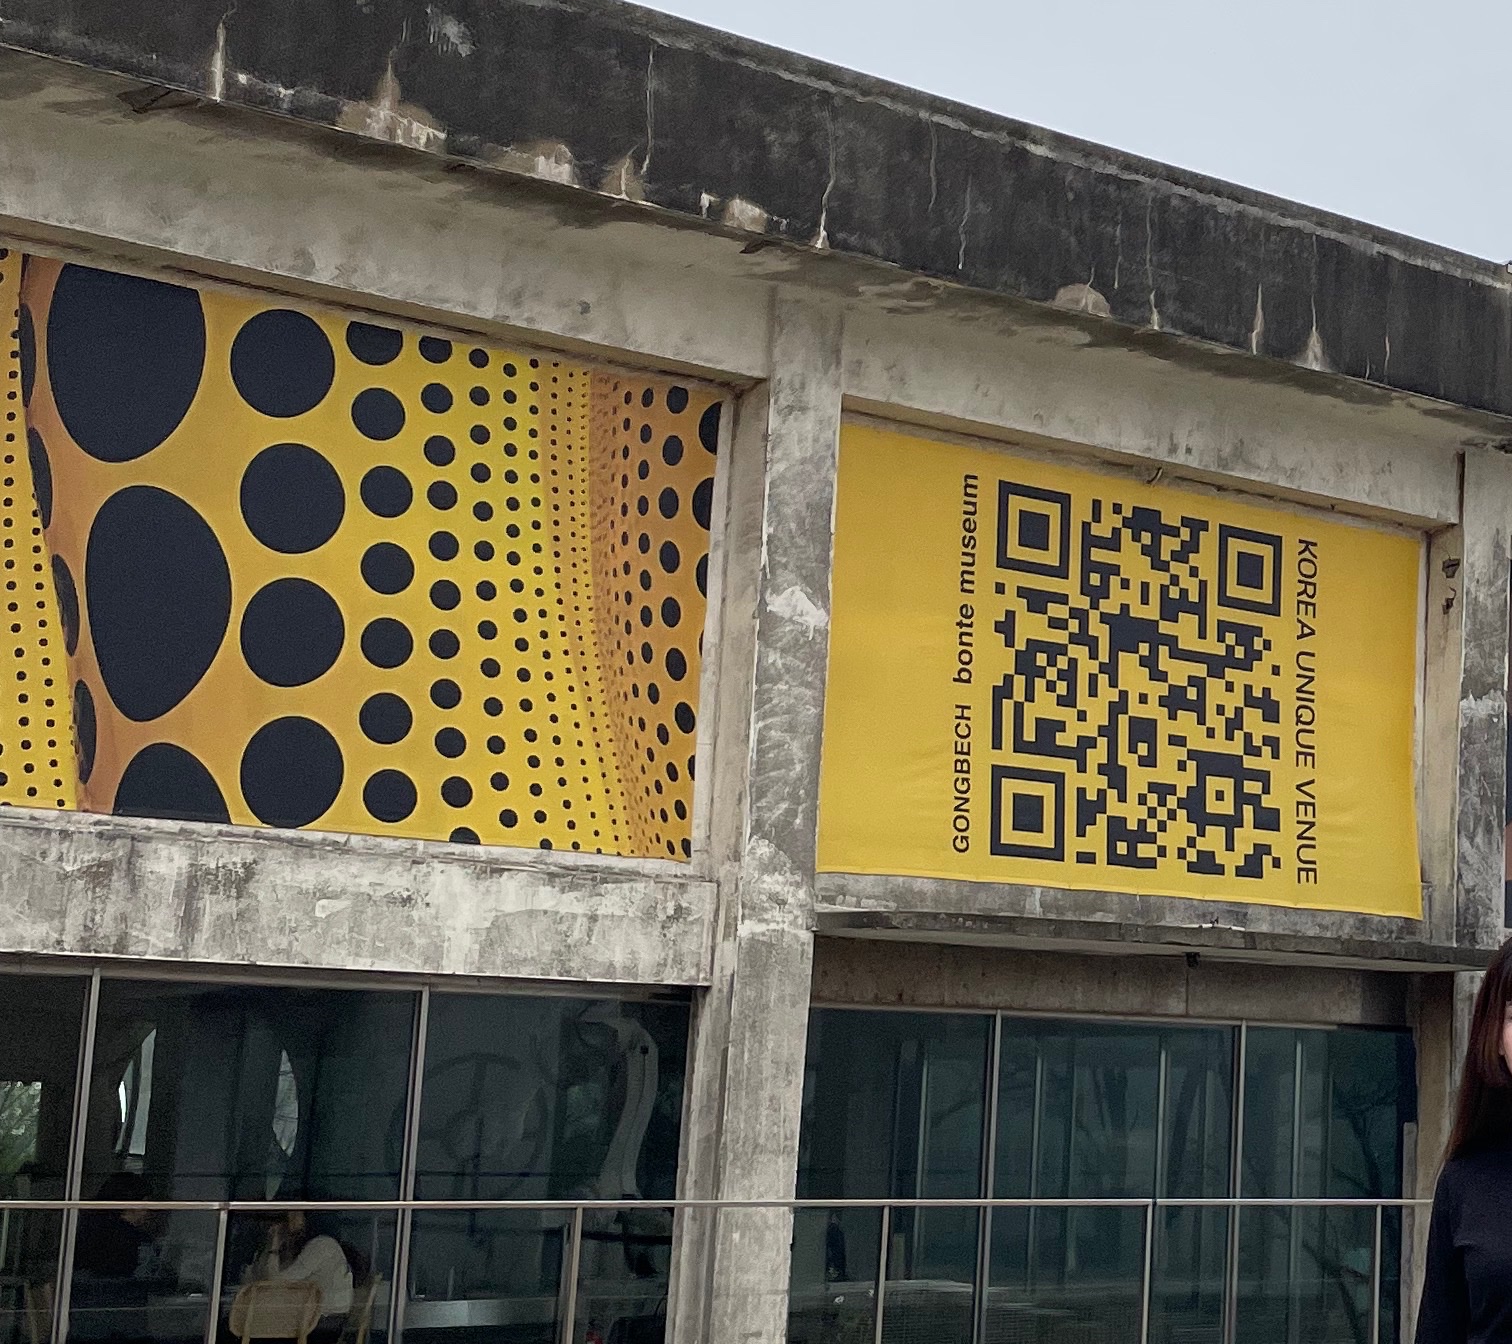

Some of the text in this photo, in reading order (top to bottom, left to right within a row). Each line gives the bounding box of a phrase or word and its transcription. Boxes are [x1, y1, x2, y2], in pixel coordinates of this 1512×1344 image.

[952, 473, 979, 854] GONGBECH bonte museum
[1295, 538, 1318, 885] KOREA UNIQUE VENUE
